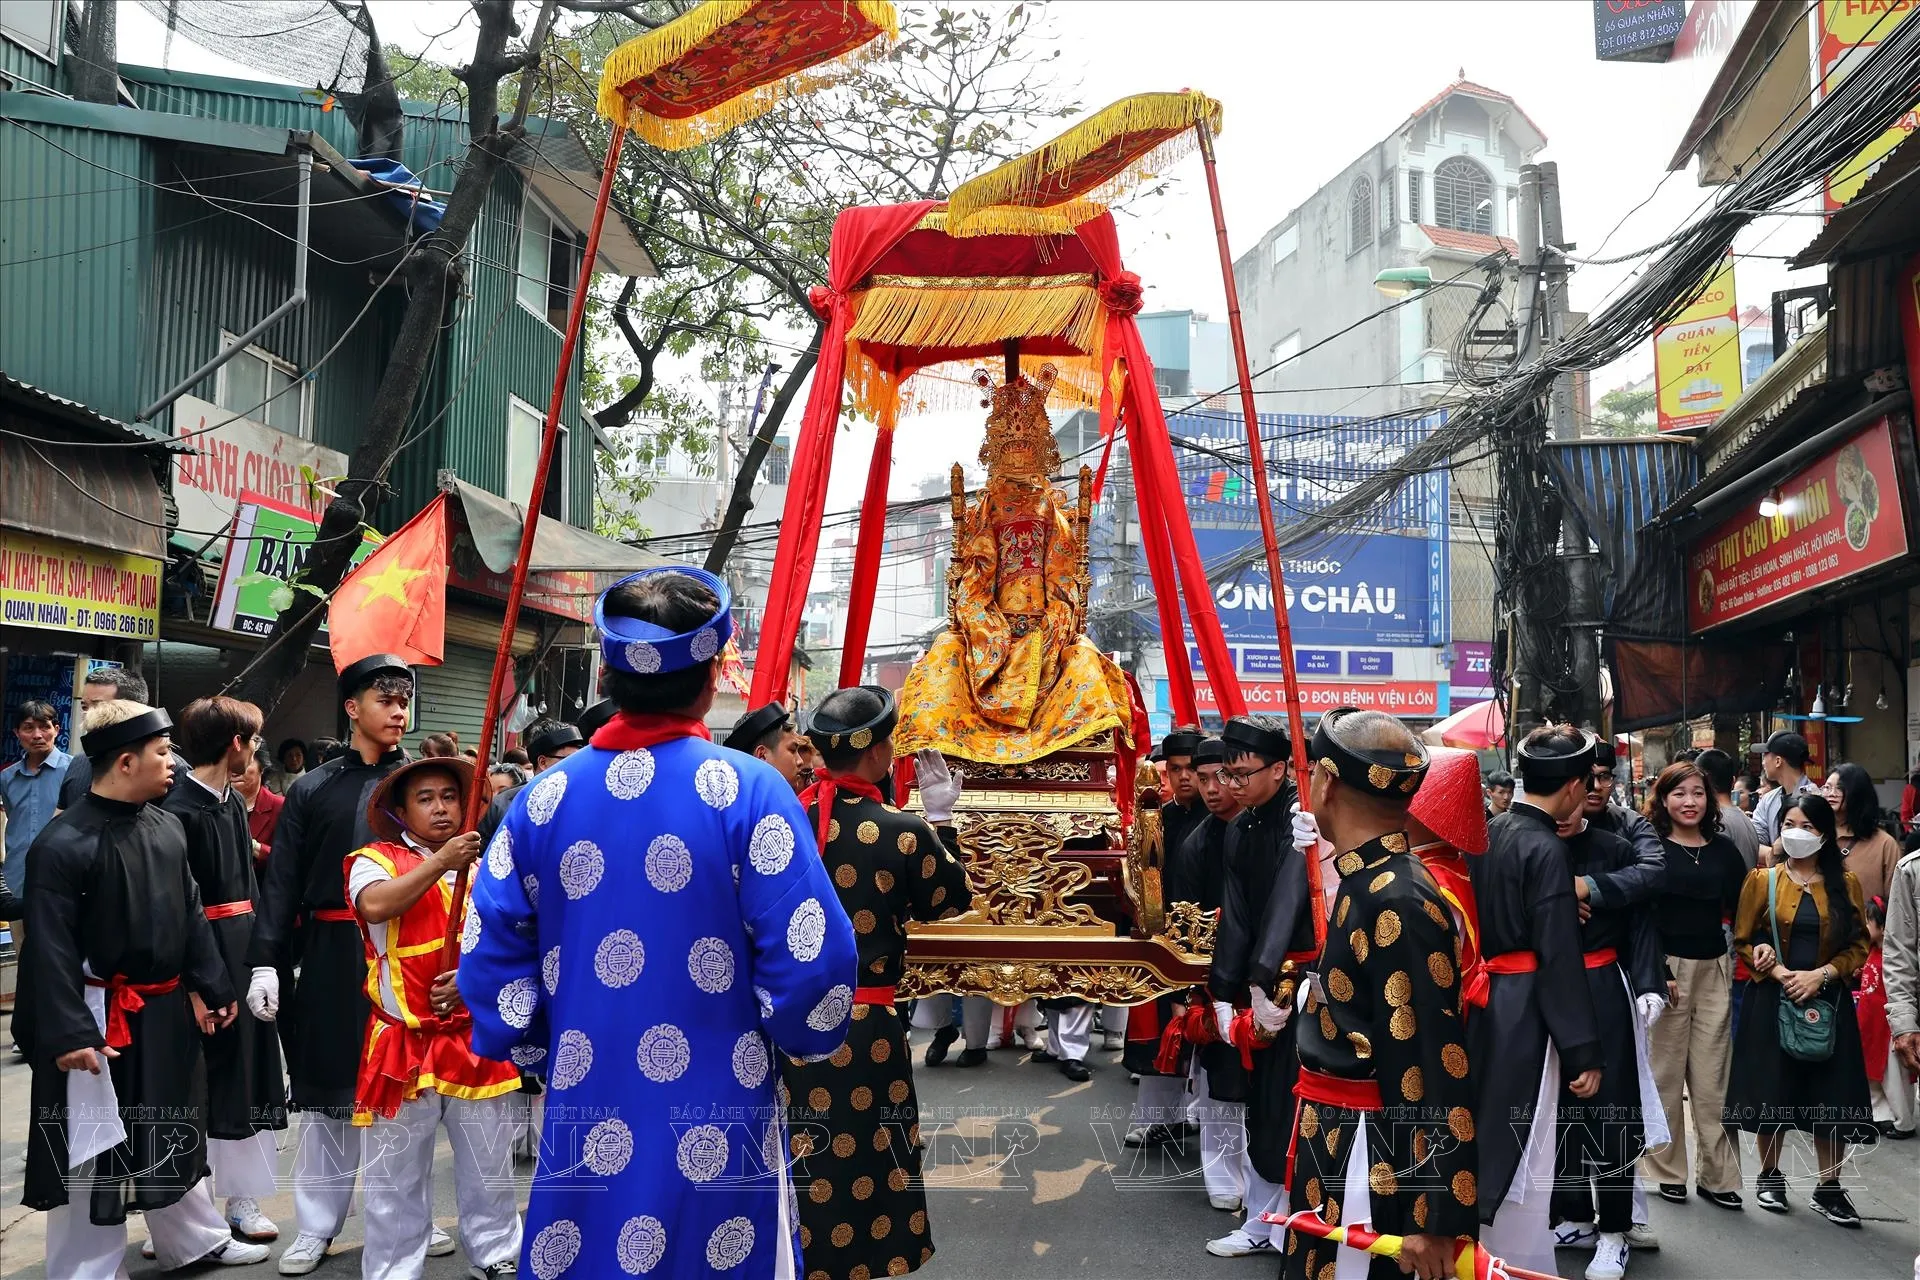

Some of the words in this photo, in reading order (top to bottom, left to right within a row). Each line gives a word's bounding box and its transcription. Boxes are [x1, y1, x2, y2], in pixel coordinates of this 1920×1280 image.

[1617, 16, 1645, 29] QUAN
[1647, 5, 1675, 22] NHÂN
[1846, 0, 1912, 16] HAB
[1677, 326, 1716, 342] QUÁN
[179, 415, 239, 499] BÁNH
[1430, 475, 1439, 538] ONG
[1288, 554, 1342, 574] THUỐC
[1718, 531, 1741, 572] THỊT
[139, 564, 157, 611] QUẢ
[1300, 581, 1396, 614] CHÂU
[5, 600, 35, 622] QUAN
[38, 602, 67, 625] NHÂN
[77, 609, 91, 628] ĐT:
[94, 611, 116, 631] 0966
[119, 615, 135, 634] 266
[138, 617, 154, 635] 618
[255, 621, 264, 632] 45
[1311, 690, 1339, 704] ĐƠN
[1343, 688, 1374, 708] BỆNH
[1378, 689, 1404, 709] VIỆN
[1408, 689, 1433, 705] LỚN
